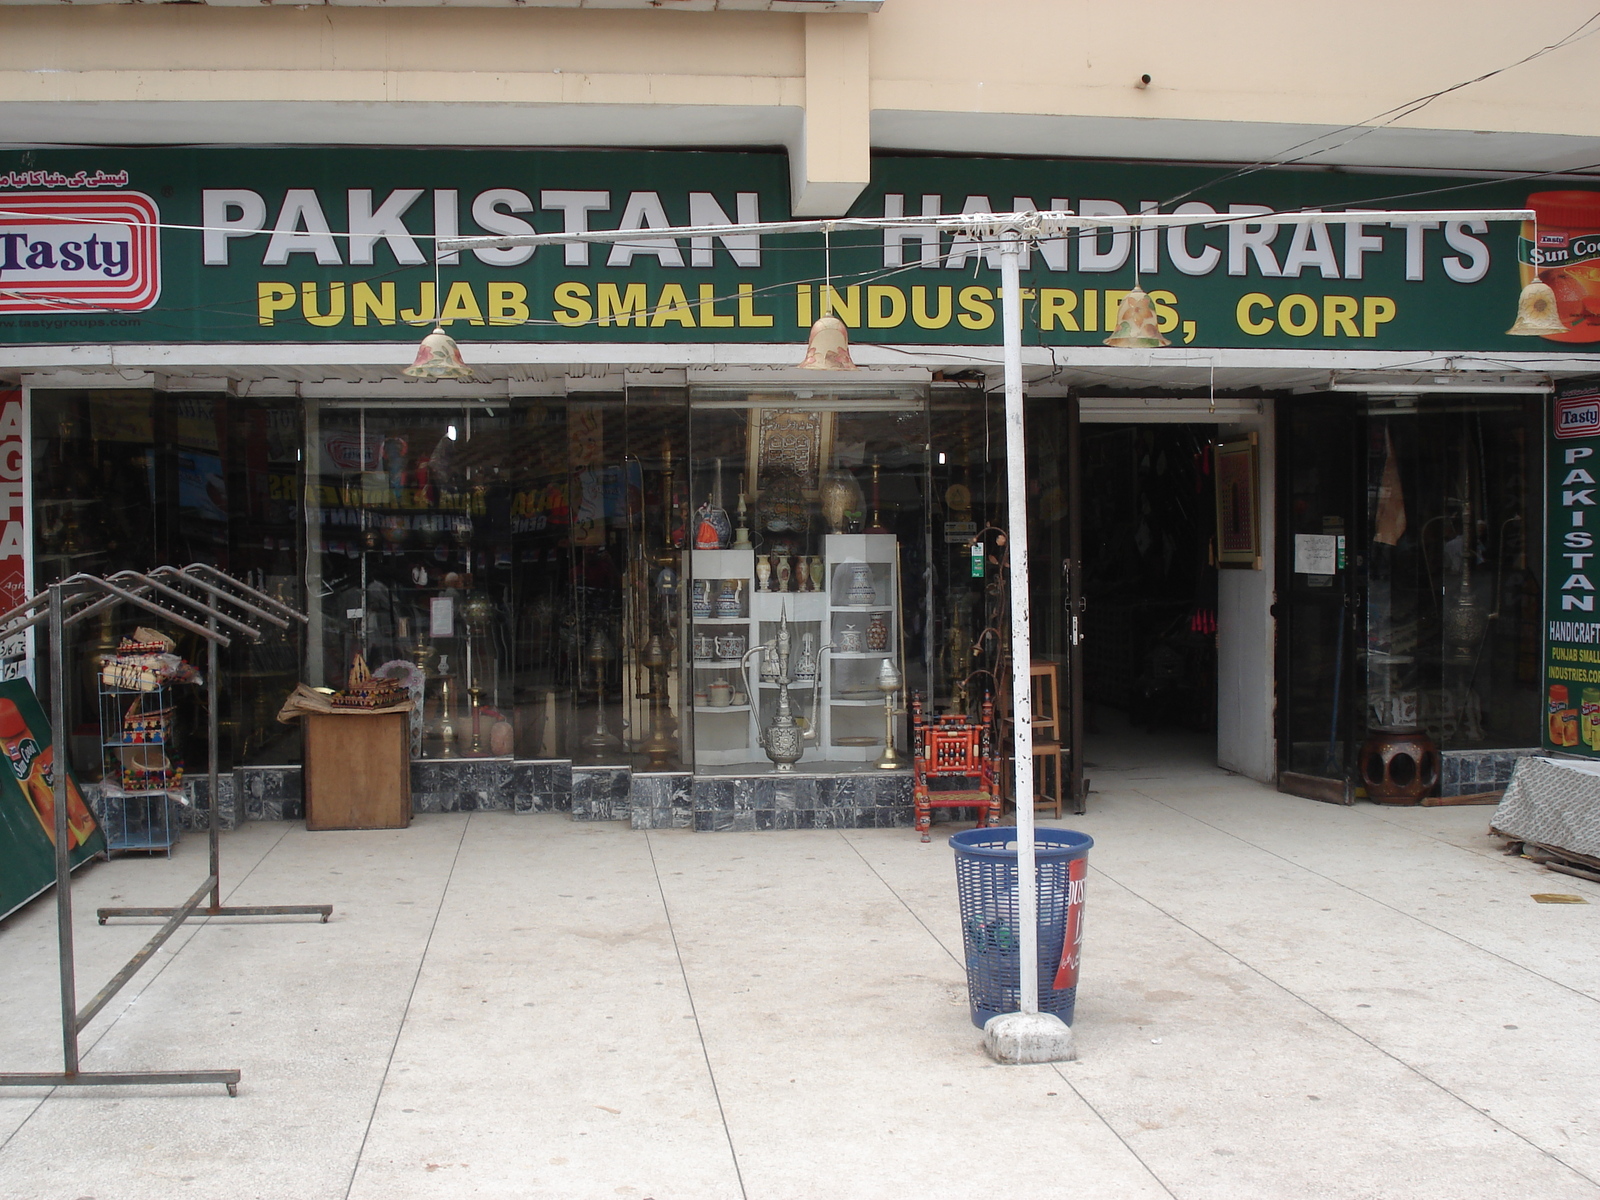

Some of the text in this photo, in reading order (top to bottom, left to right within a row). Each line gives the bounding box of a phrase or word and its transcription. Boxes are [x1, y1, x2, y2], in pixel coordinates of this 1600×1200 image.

[202, 187, 761, 268] PAKISTAN
[883, 193, 1491, 284] HANDICRAFTS
[0, 232, 129, 277] Tasty
[1529, 248, 1569, 264] Sun
[0, 317, 141, 329] w.tastygroups.com
[257, 281, 530, 327] PUNJAB
[553, 282, 774, 328] SMALL
[1235, 292, 1398, 338] CORP
[1562, 409, 1598, 424] Tasty
[0, 401, 24, 560] AGFA
[1560, 447, 1597, 612] PAKISTAN
[1552, 647, 1578, 662] PUNJAB
